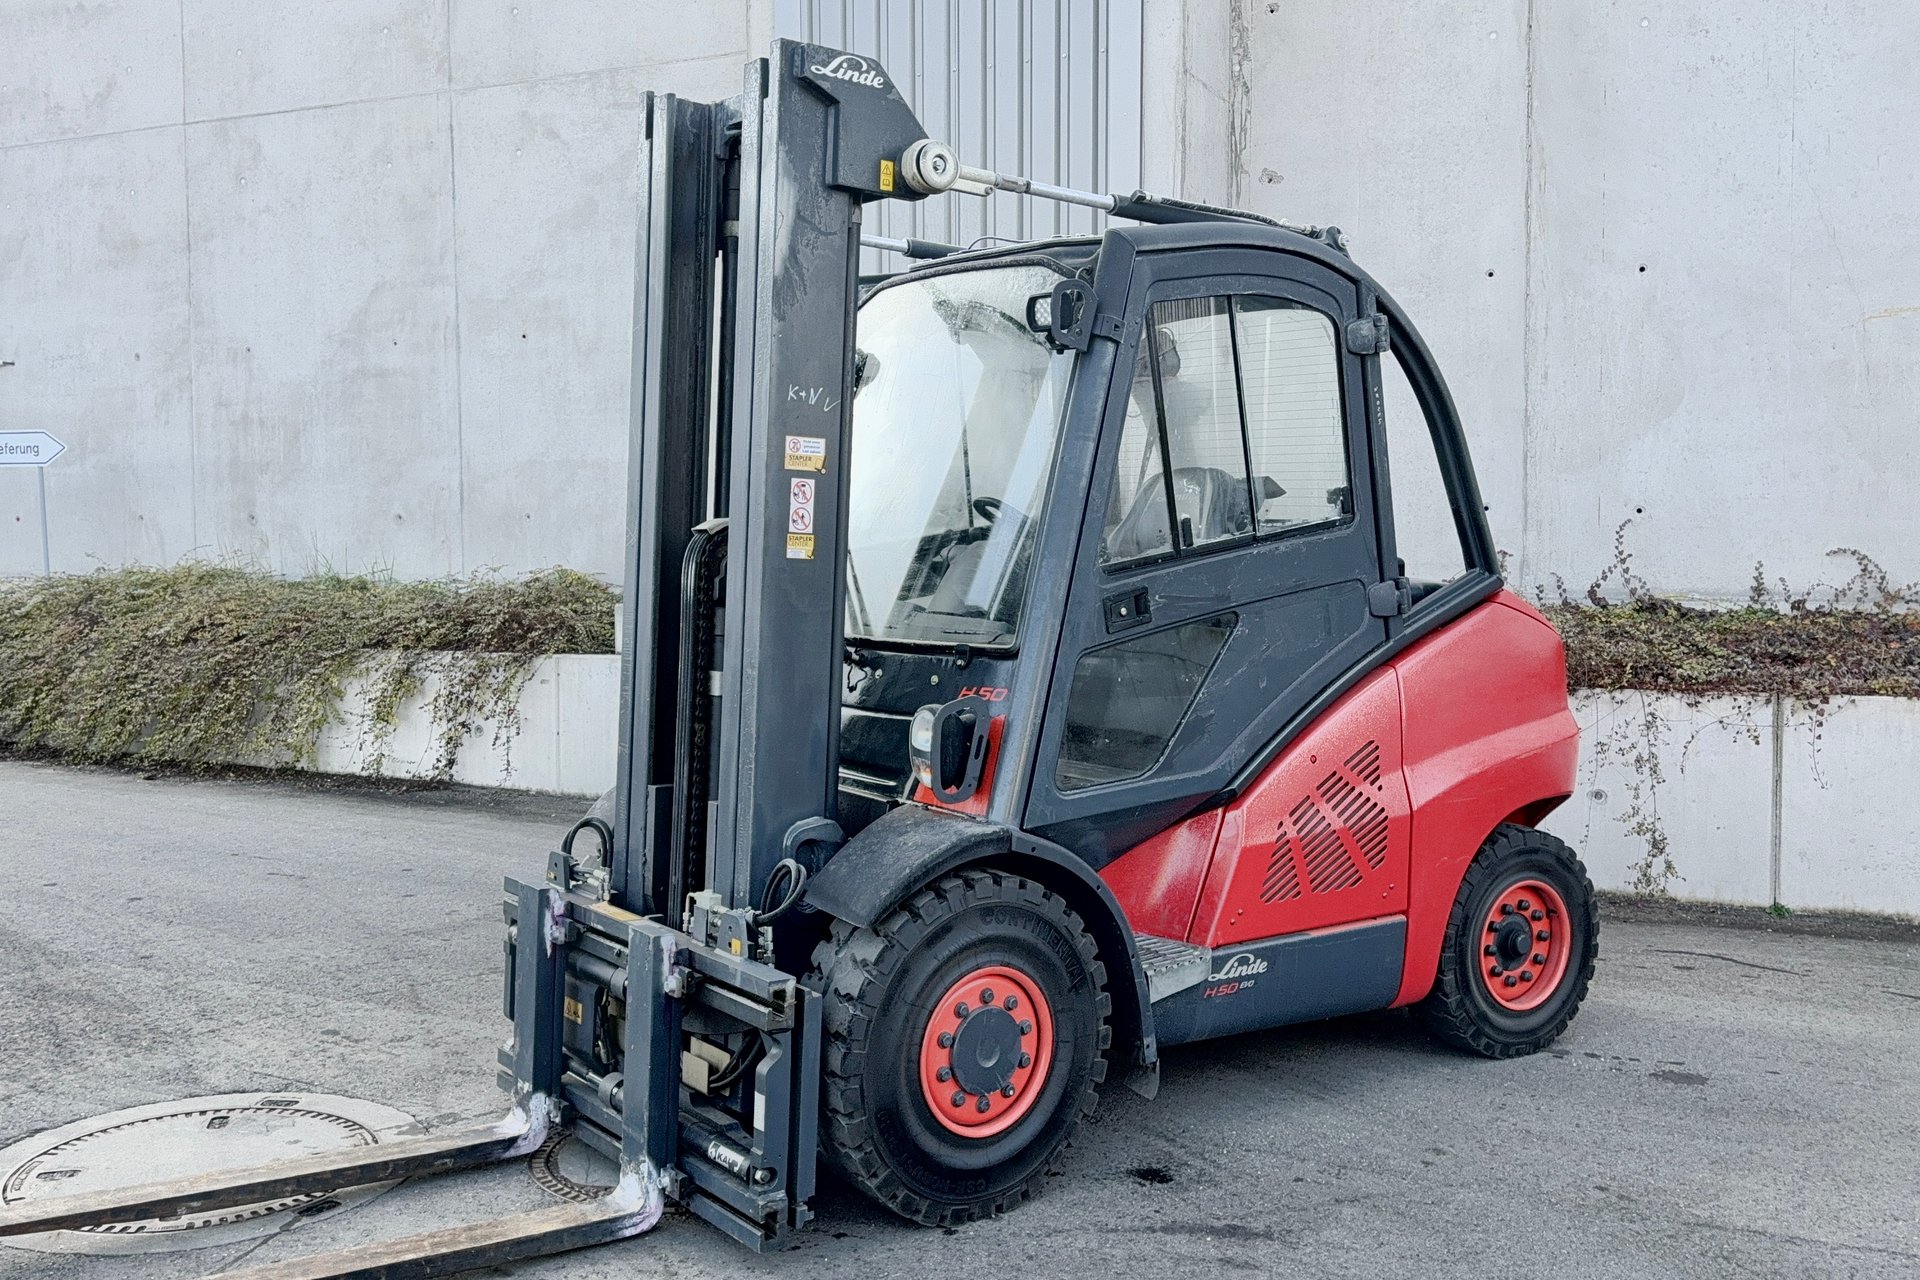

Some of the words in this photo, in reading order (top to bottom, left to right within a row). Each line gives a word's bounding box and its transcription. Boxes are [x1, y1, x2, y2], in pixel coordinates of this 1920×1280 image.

[810, 55, 884, 89] Linde
[789, 454, 812, 462] STAPLER
[1207, 953, 1269, 982] Linde
